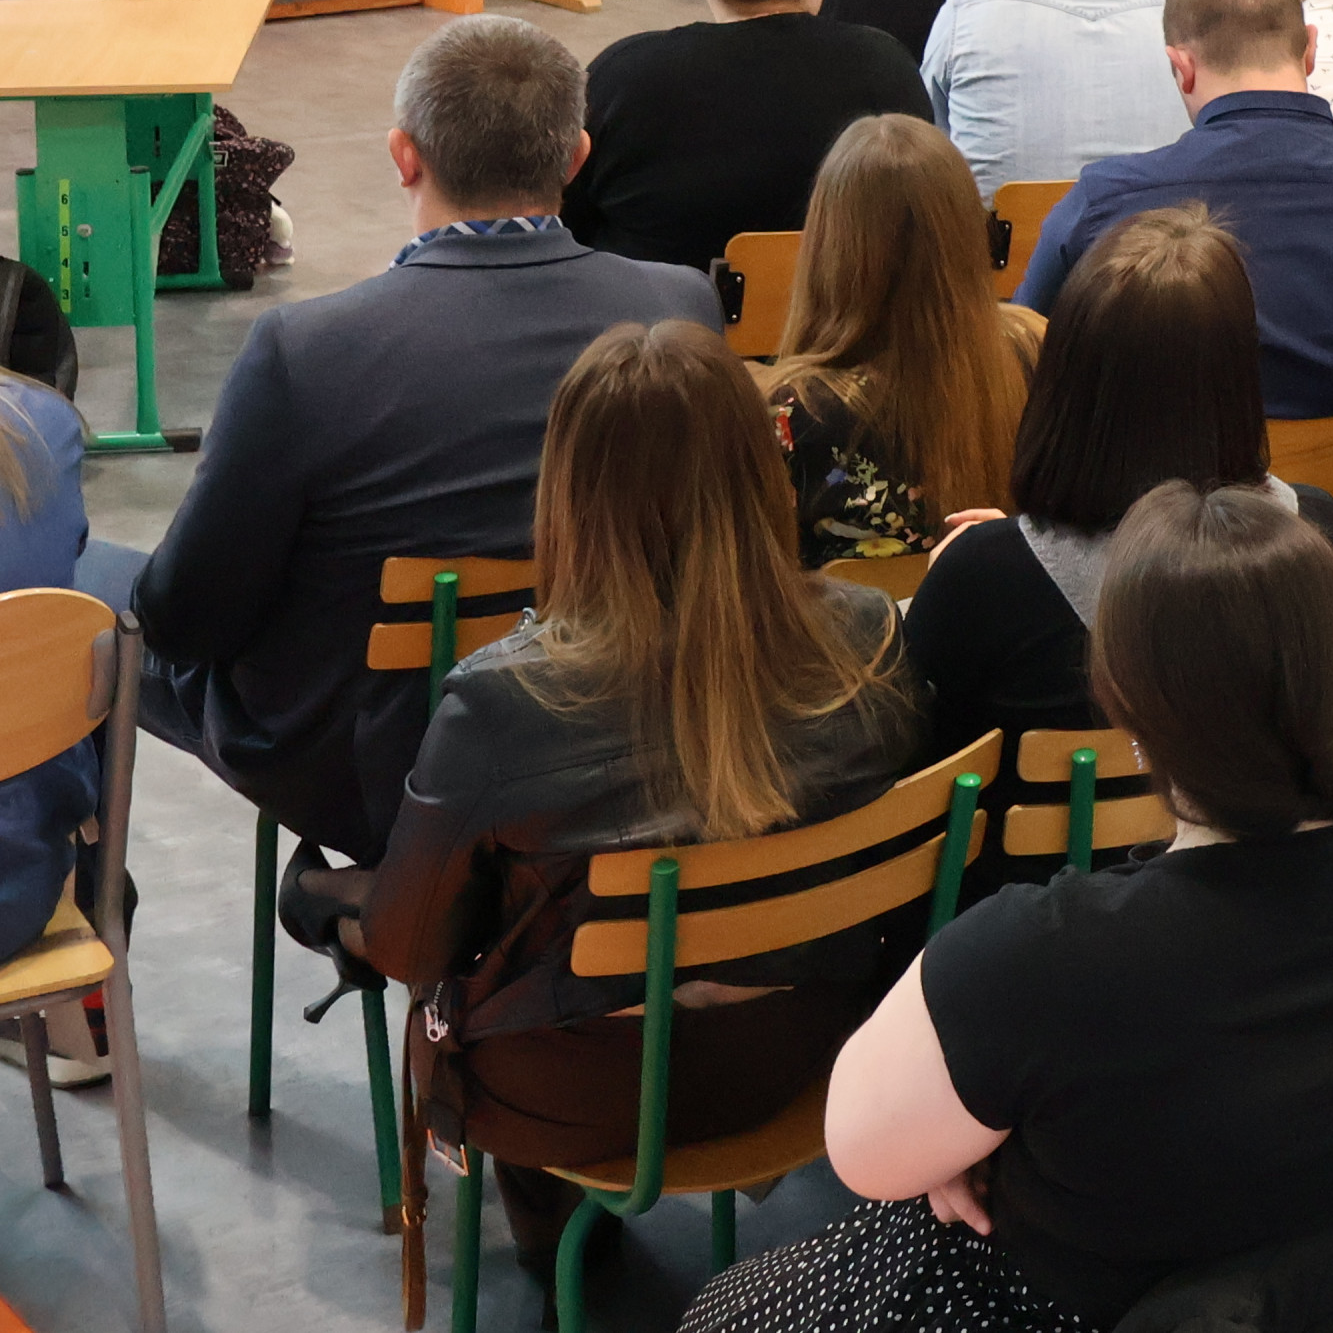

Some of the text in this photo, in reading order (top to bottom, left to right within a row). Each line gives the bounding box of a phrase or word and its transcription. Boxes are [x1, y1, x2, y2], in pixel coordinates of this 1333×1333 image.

[61, 193, 69, 205] 6
[61, 225, 69, 237] 5
[61, 257, 69, 268] 4
[62, 289, 69, 300] 3
